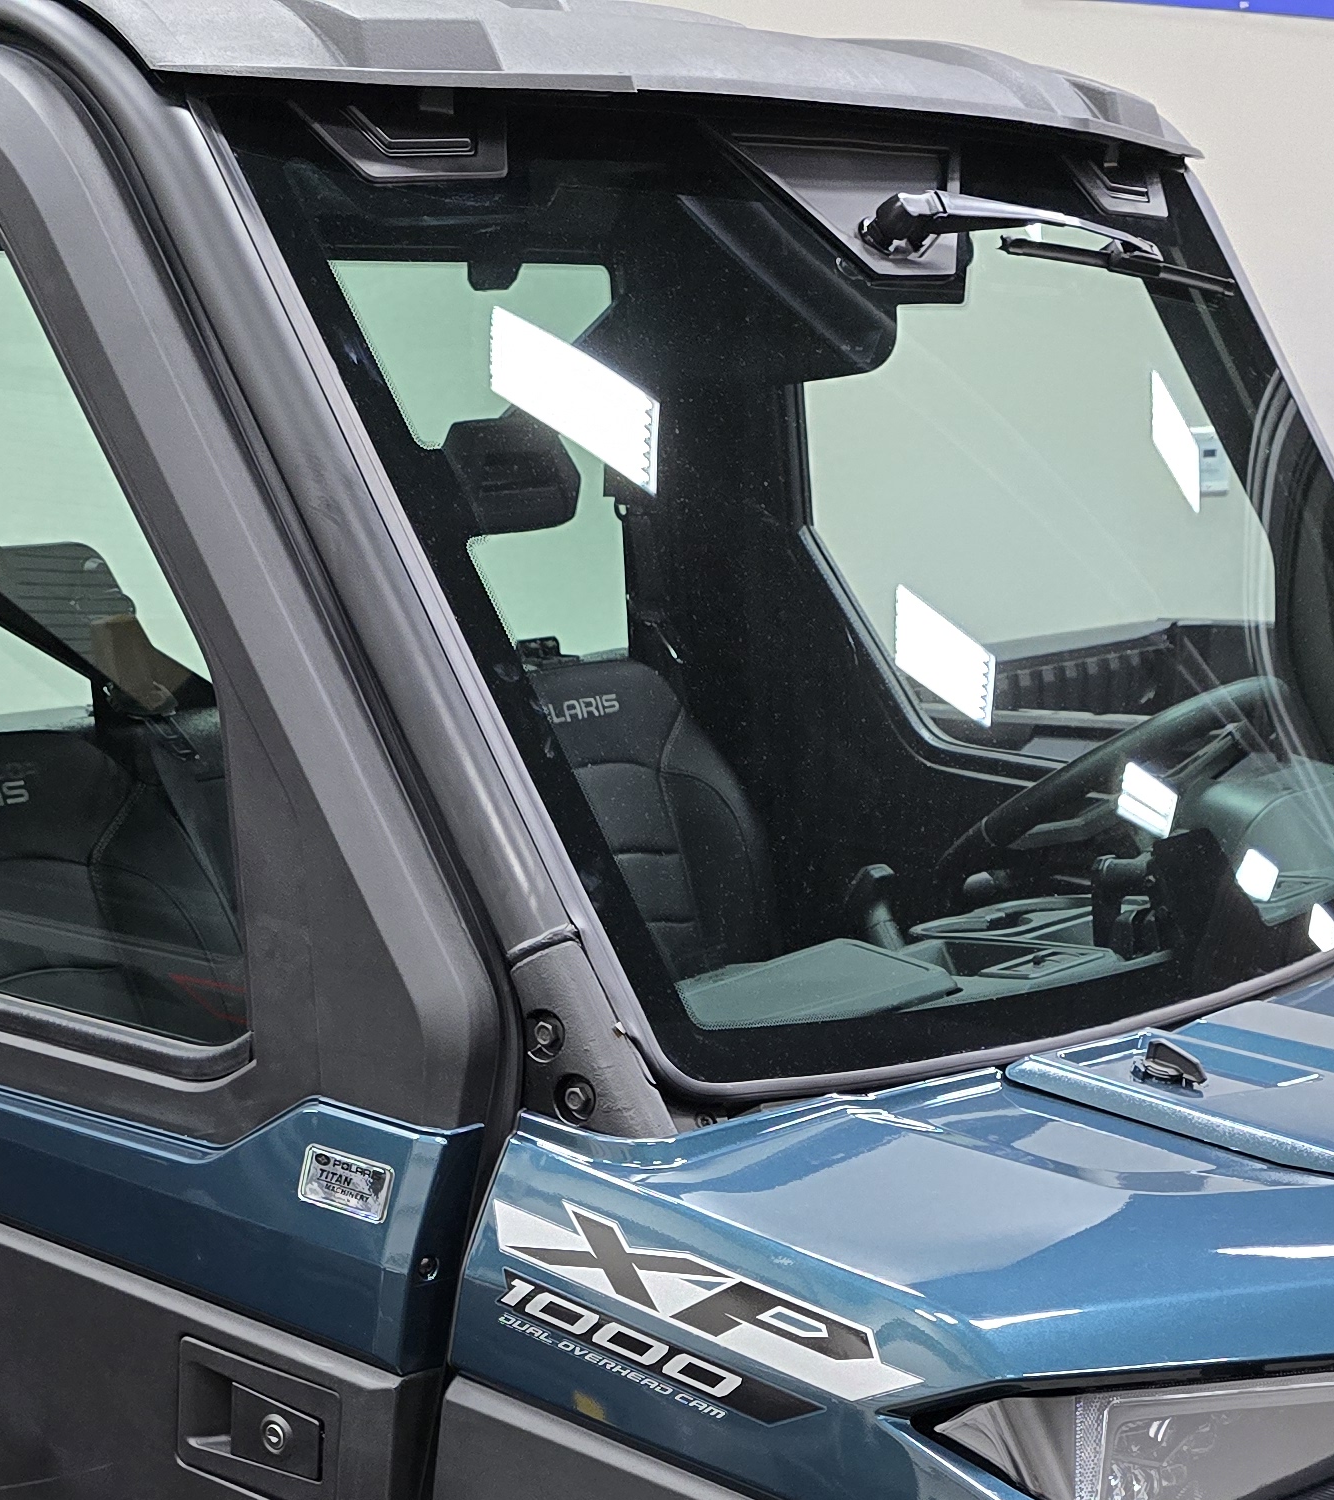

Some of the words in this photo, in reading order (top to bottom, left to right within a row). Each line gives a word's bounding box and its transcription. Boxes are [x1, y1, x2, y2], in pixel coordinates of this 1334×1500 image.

[544, 693, 621, 725] LARIS
[318, 1167, 353, 1187] TITAN
[332, 1158, 384, 1181] POLAR
[324, 1182, 371, 1203] MACHINERY
[506, 1208, 879, 1362] XP
[500, 1278, 744, 1399] 1000
[497, 1312, 554, 1346] DUAL
[557, 1338, 675, 1396] OVERHEAD
[673, 1392, 728, 1420] CAM
